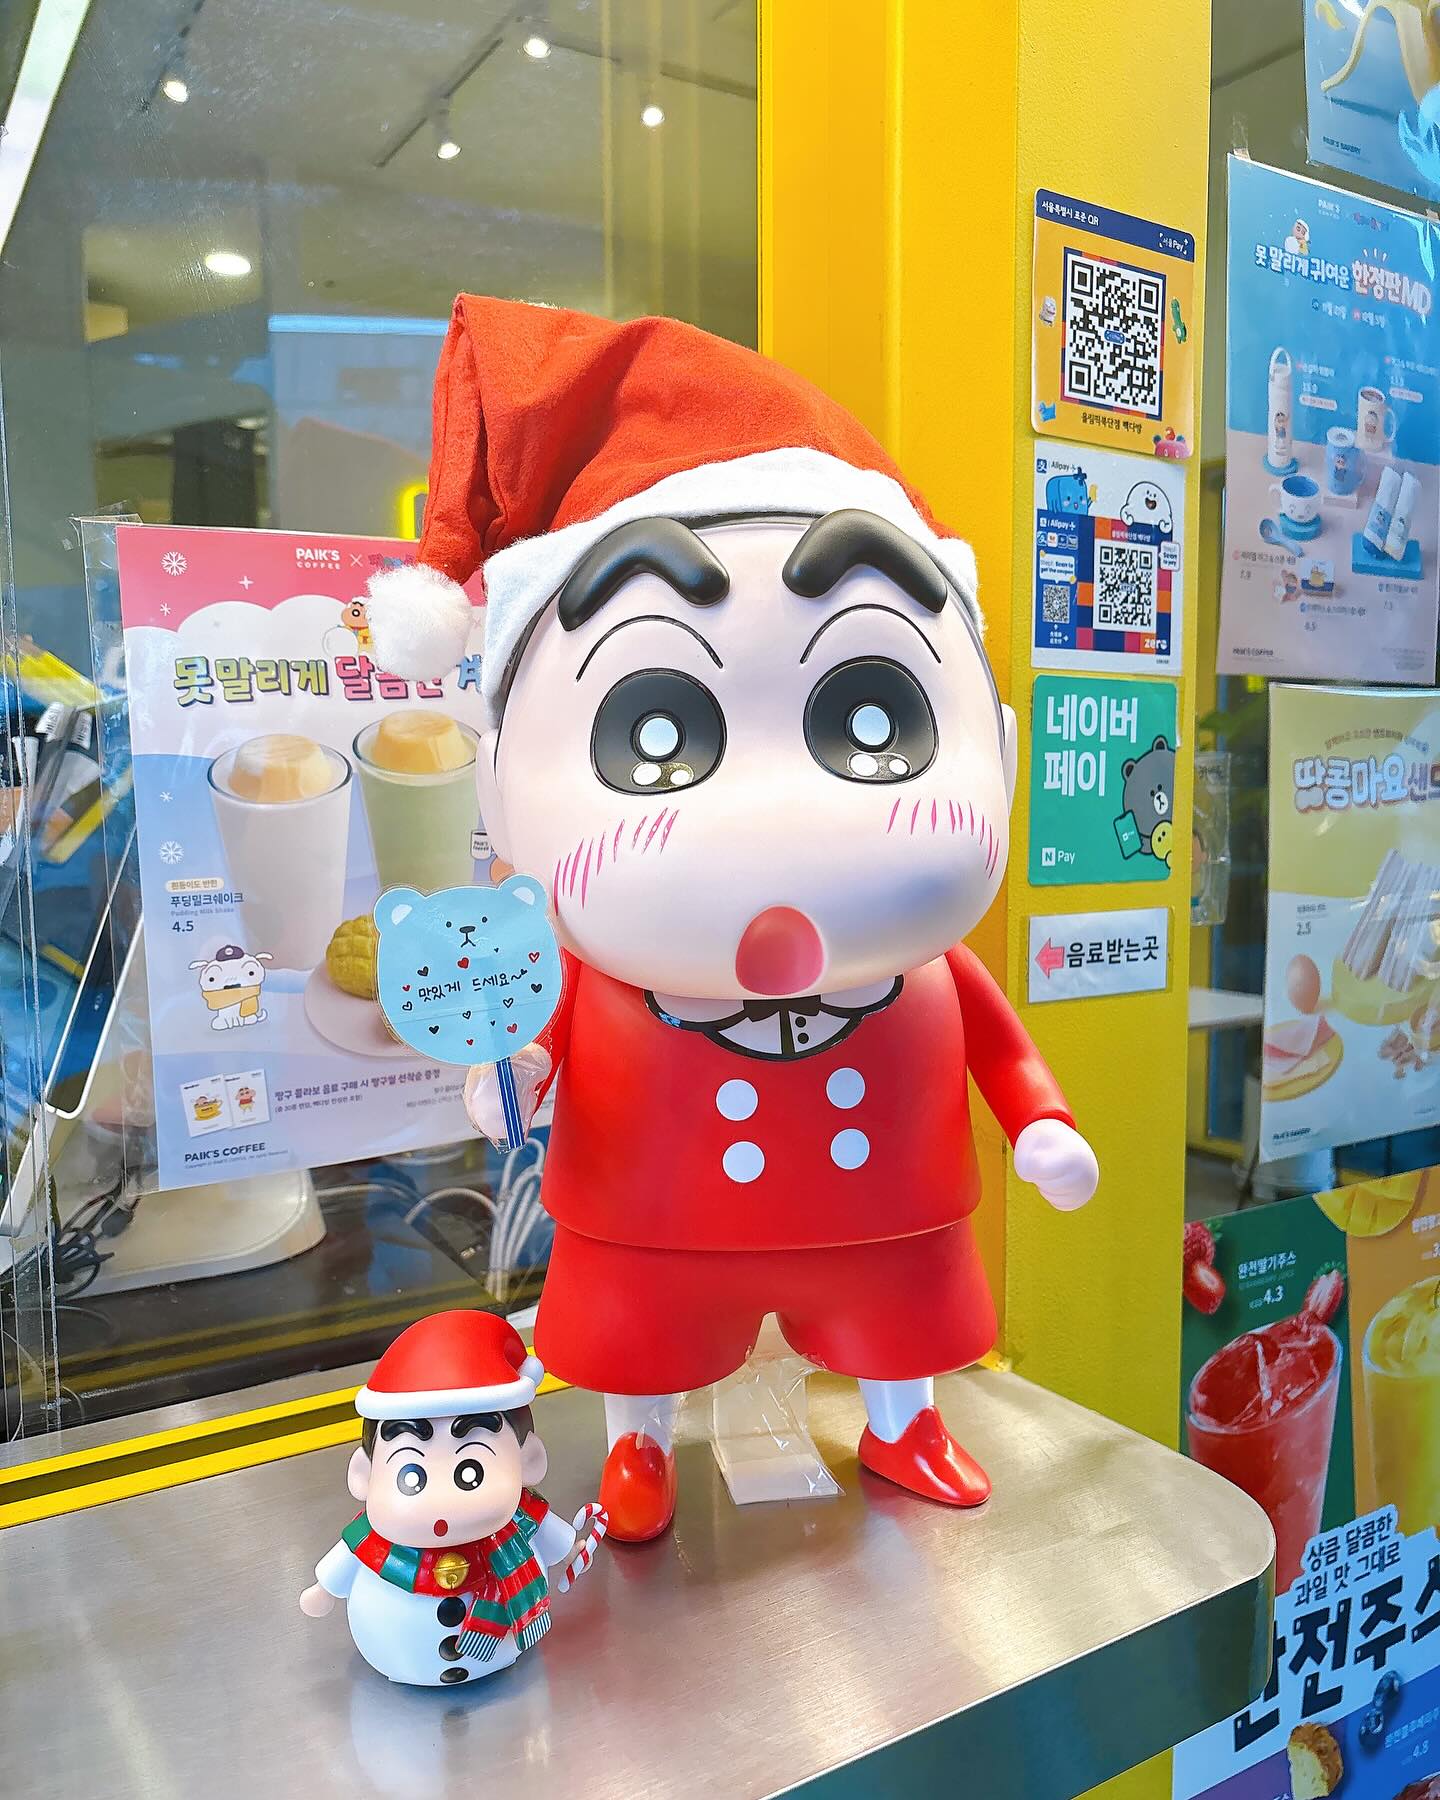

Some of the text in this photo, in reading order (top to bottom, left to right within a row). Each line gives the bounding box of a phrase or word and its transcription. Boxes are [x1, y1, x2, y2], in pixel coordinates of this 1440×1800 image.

[1041, 200, 1099, 226] 서울특별시 표준 QR
[1310, 257, 1350, 290] 귀여운
[295, 548, 341, 562] PAIK'S
[296, 561, 341, 570] COFFEE
[1046, 694, 1138, 743] 네이버
[1043, 750, 1106, 797] 페이
[1057, 850, 1076, 864] Pay
[170, 892, 245, 908] 푸딩밀크쉐이크
[172, 920, 195, 933] 4.5
[1066, 936, 1160, 969] 음료받는곳
[418, 981, 461, 1002] 맛있게
[184, 1142, 266, 1162] PAIK'S COFFEE
[1264, 1285, 1284, 1305] 4.3
[1307, 1512, 1393, 1572] 상큼 달콤한
[1294, 1541, 1401, 1607] 과일 맛 그대로
